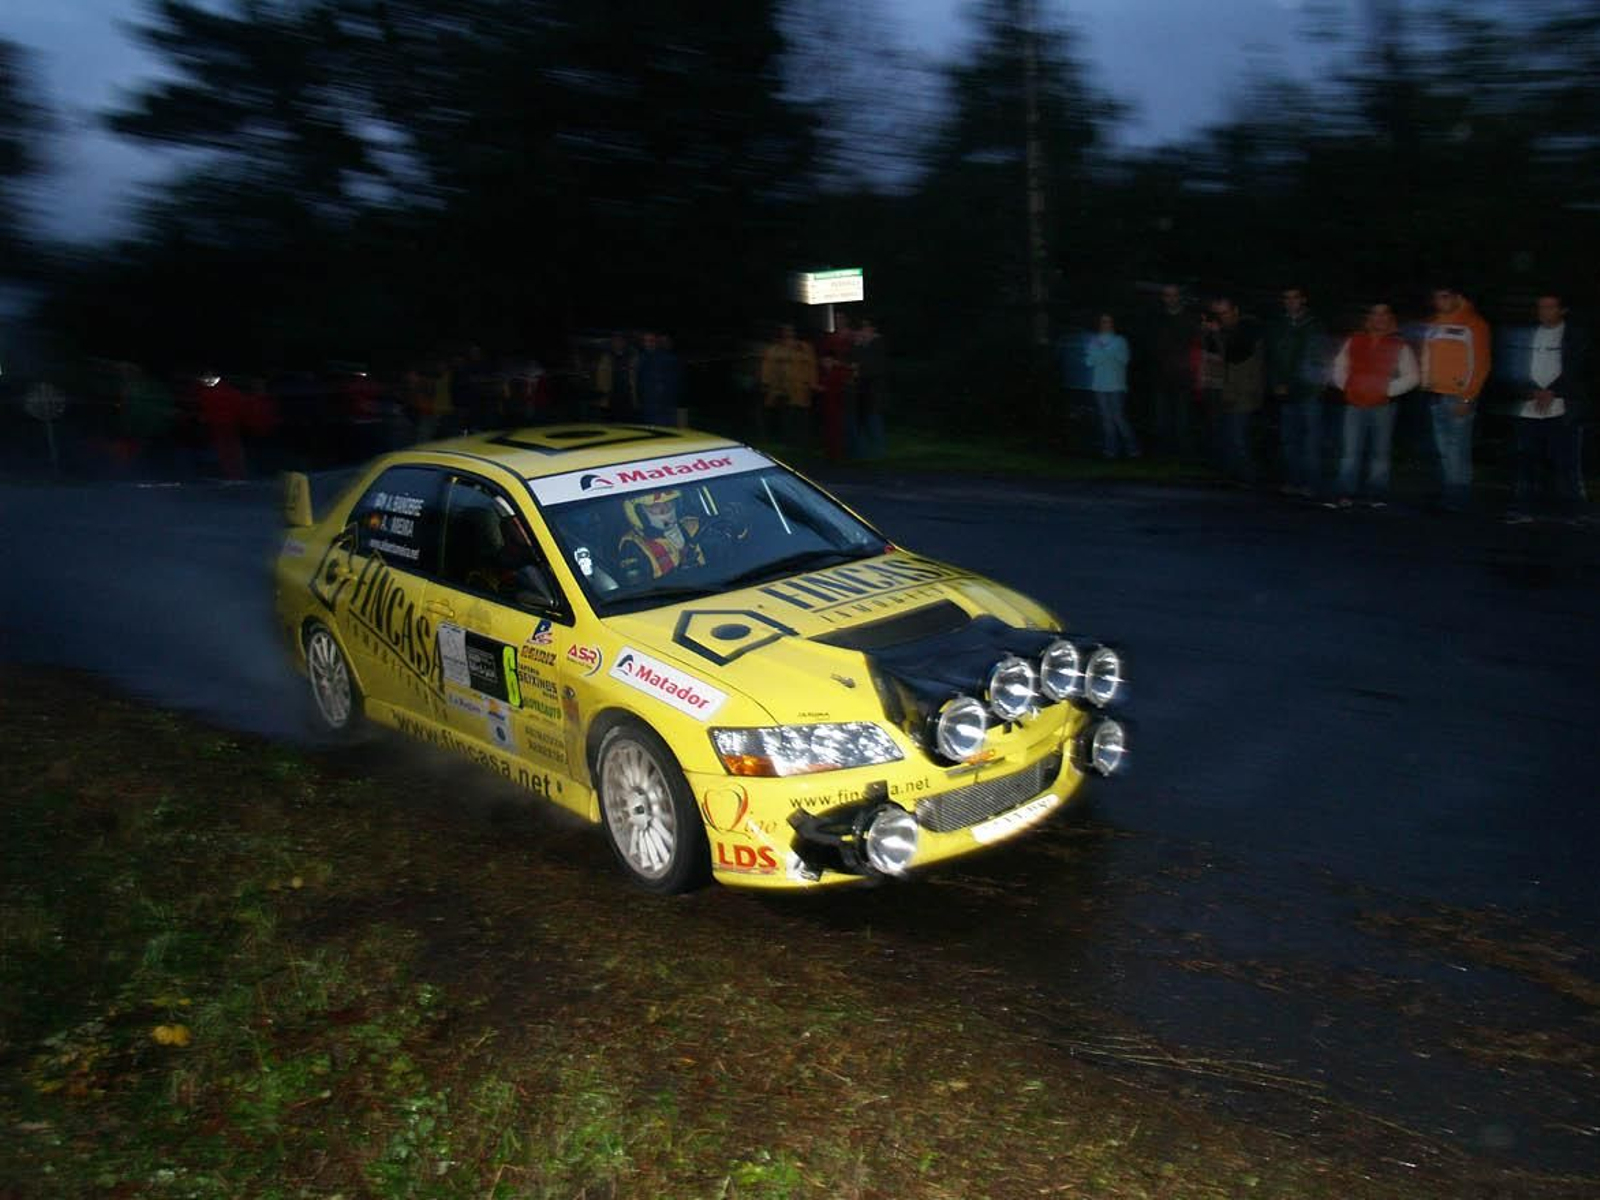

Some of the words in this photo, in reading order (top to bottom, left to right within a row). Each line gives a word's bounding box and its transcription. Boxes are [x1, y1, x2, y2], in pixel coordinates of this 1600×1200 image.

[617, 456, 733, 484] Matador
[350, 550, 446, 696] FINCASA
[567, 644, 598, 665] ASR
[502, 645, 522, 708] 6
[635, 664, 711, 709] Matador
[391, 707, 551, 799] www.fincasa.net
[788, 775, 931, 808] www.fina.net
[717, 842, 778, 869] LDS
